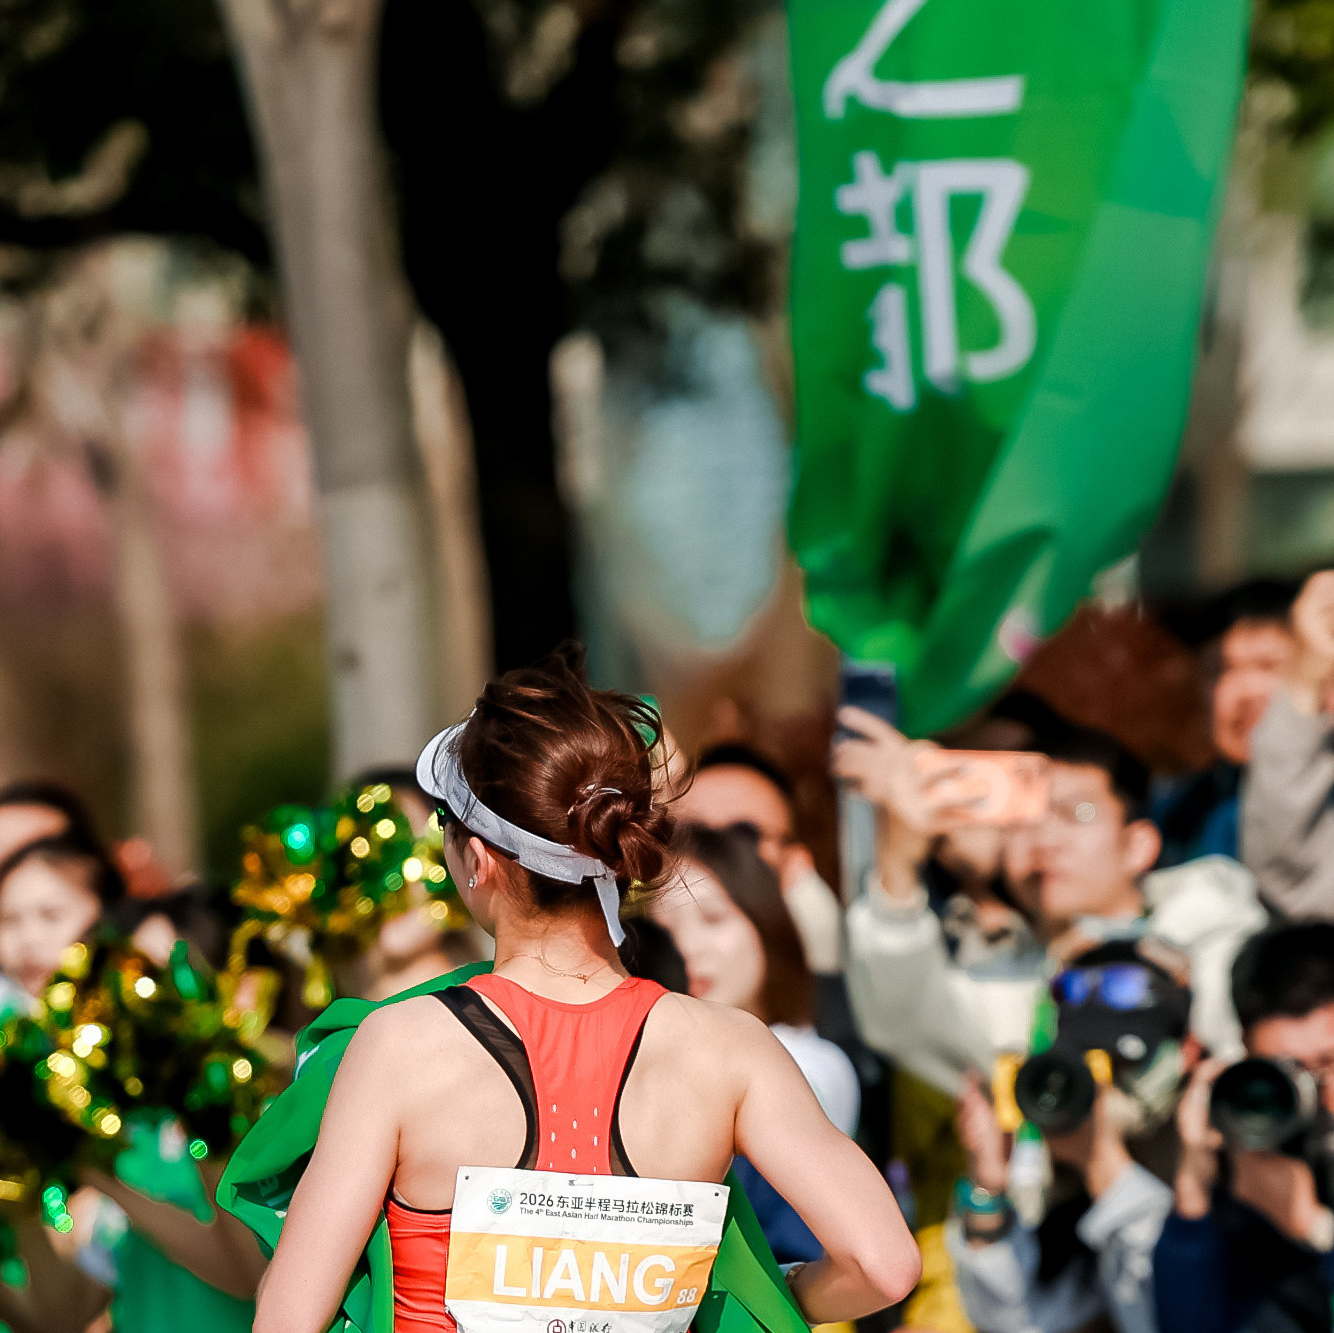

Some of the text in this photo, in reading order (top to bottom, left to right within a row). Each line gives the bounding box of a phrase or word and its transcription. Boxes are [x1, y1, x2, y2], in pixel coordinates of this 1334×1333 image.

[520, 1207, 534, 1215] The
[545, 1209, 561, 1217] East
[562, 1210, 583, 1219] Asian
[584, 1211, 599, 1220] Half
[600, 1213, 636, 1222] Marathon
[637, 1215, 694, 1227] Championships
[493, 1244, 676, 1305] LIANG
[676, 1287, 698, 1305] 88
